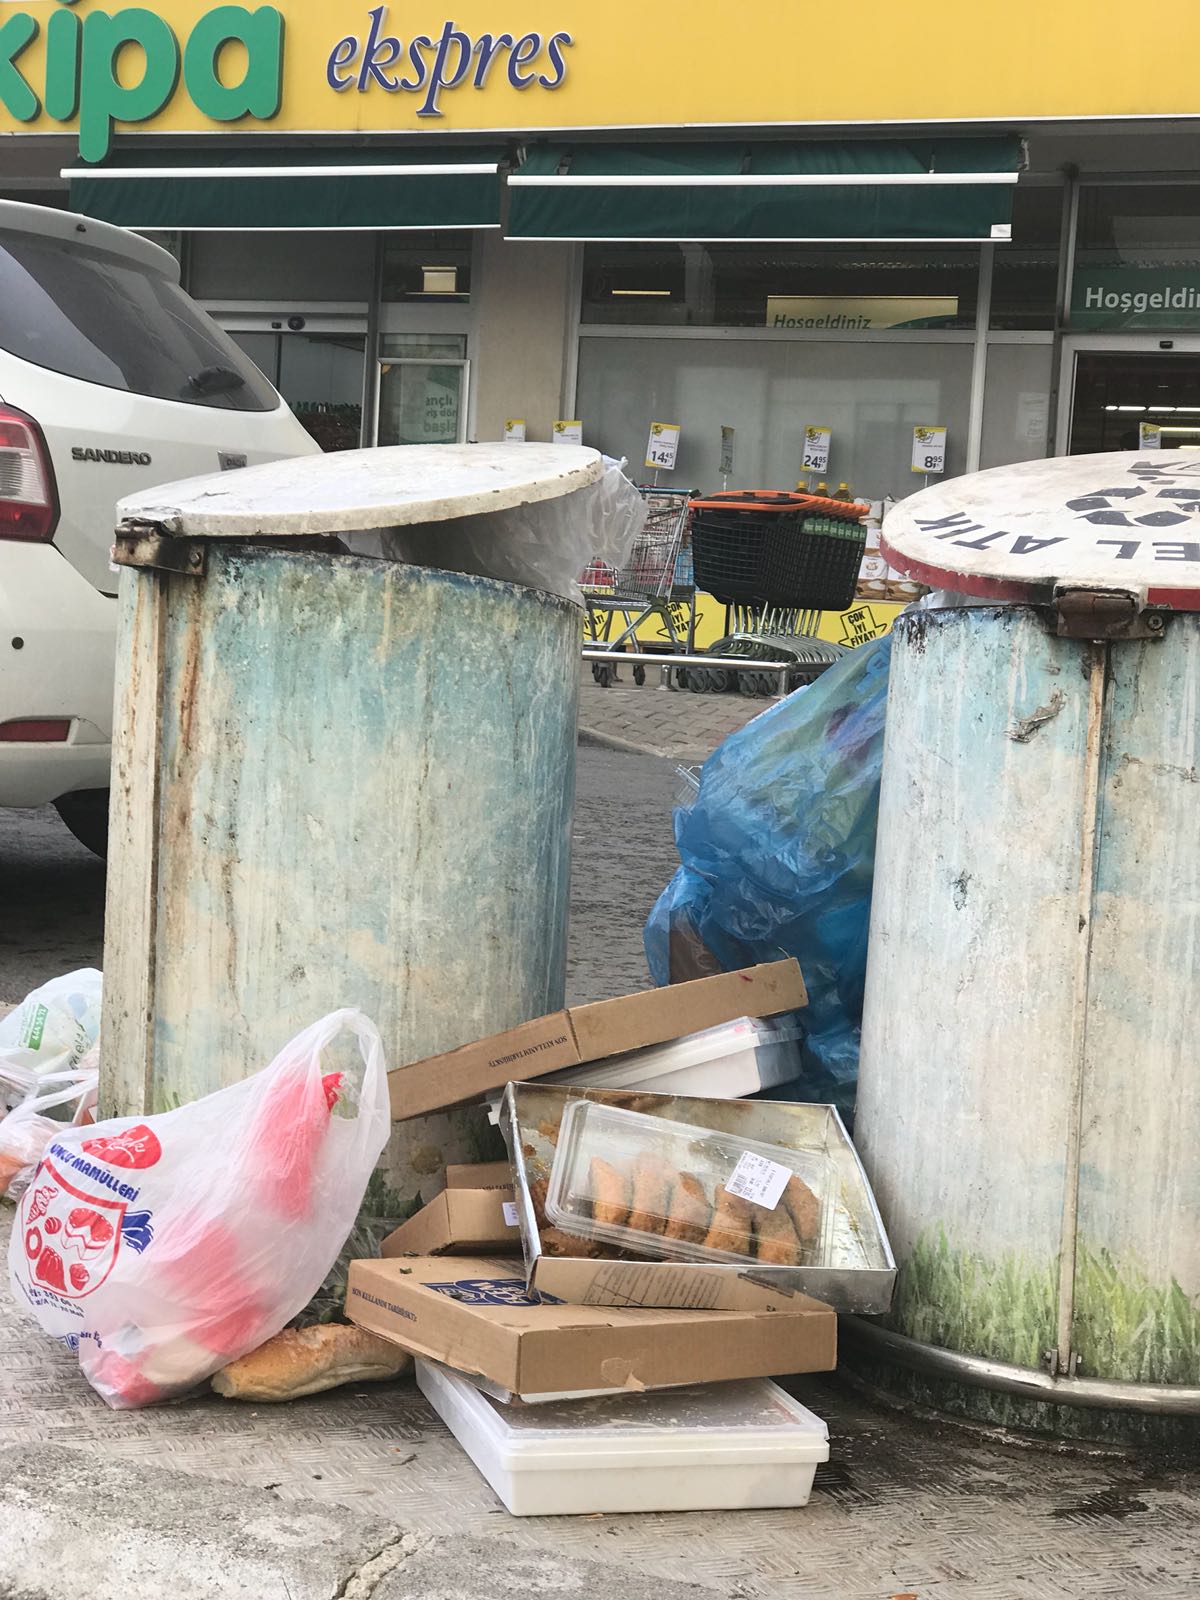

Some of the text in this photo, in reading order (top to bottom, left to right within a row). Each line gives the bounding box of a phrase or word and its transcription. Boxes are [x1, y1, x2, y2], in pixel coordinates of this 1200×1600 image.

[326, 5, 574, 118] ekspres
[71, 446, 152, 466] SANDERO
[847, 610, 866, 627] ÇOK
[853, 621, 867, 635] İYİ
[850, 630, 877, 647] FİYAT!
[72, 1157, 141, 1203] MAMÜLLERİ
